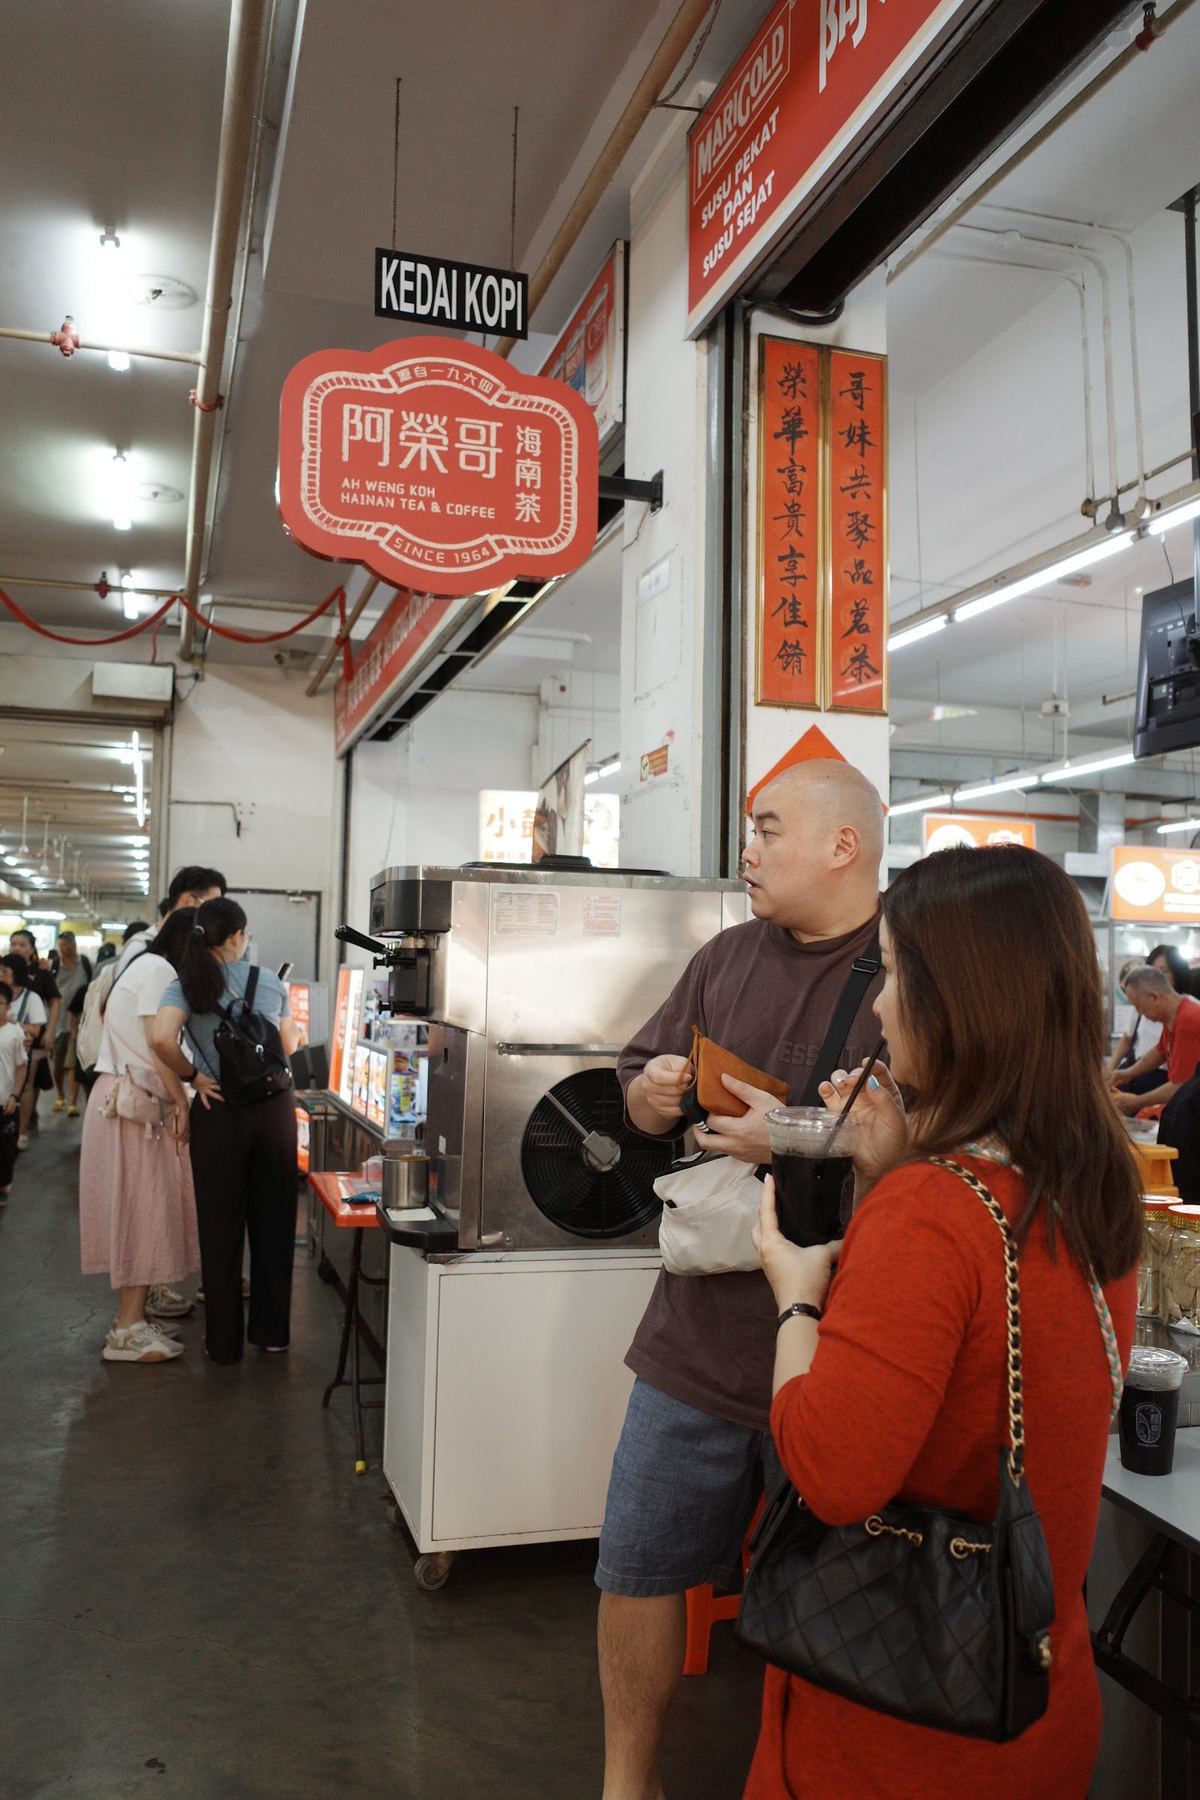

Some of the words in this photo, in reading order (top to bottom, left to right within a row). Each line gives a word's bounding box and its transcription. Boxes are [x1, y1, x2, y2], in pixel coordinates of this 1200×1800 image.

[697, 24, 785, 189] MARIGOLD
[701, 170, 732, 229] SUSU
[734, 106, 780, 185] PEKAT
[723, 171, 753, 226] DAN
[703, 223, 734, 278] SUSU
[736, 169, 775, 236] SEJAT
[381, 256, 458, 322] KEDAI
[465, 273, 523, 332] KOPI
[341, 403, 503, 479] 阿榮哥
[515, 425, 543, 524] 海南茶
[341, 478, 361, 490] AH
[366, 480, 405, 495] WENG
[410, 484, 436, 498] KOH
[341, 492, 395, 509] HAINAN
[400, 498, 428, 512] TEA
[431, 501, 441, 513] &
[446, 503, 496, 519] COFFEE
[393, 537, 446, 564] SINCE
[454, 546, 491, 564] 1964
